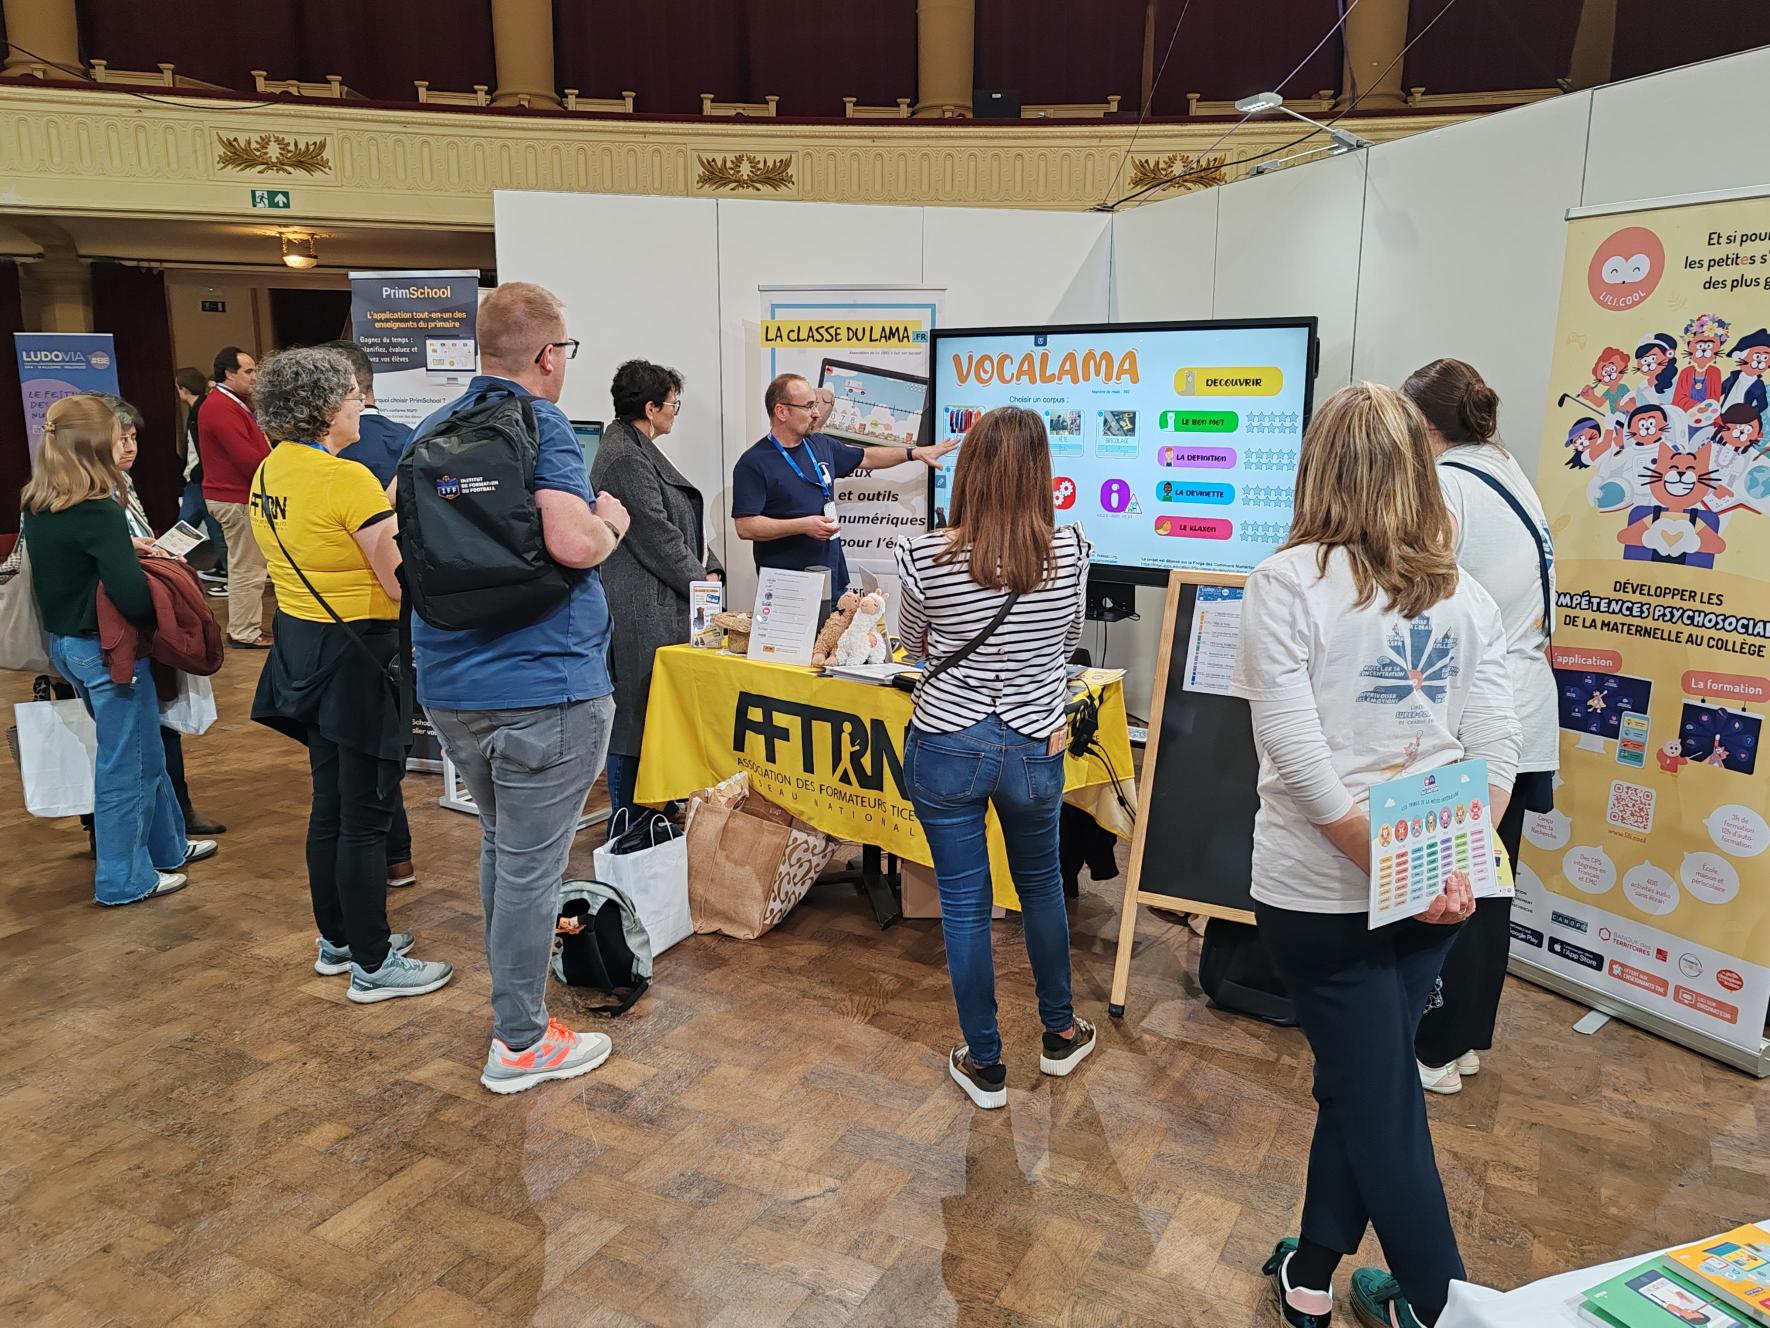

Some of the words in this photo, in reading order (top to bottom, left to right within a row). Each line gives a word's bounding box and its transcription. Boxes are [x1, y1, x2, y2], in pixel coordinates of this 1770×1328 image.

[1707, 231, 1723, 246] Et
[1725, 230, 1738, 245] si
[1684, 255, 1704, 270] les
[1707, 252, 1757, 272] petites
[1702, 275, 1728, 290] des
[1730, 273, 1761, 292] plus
[382, 286, 451, 299] PrimSchool
[1599, 290, 1647, 307] LILI.COOL
[366, 311, 412, 320] L'application
[413, 311, 453, 319] tout-en-un
[454, 310, 467, 319] des
[374, 321, 418, 330] enseignants
[418, 320, 428, 328] du
[428, 320, 460, 329] primaire
[764, 325, 784, 342] LA
[846, 326, 866, 342] DU
[869, 325, 911, 343] LAMA
[22, 351, 86, 361] LUDOVIA
[952, 350, 1140, 385] VOCALAMA
[1205, 378, 1262, 387] DECOUVRIR
[1009, 395, 1031, 403] Choisir
[1042, 397, 1065, 405] corpus
[838, 490, 853, 501] et
[857, 490, 899, 502] outils
[838, 513, 926, 528] numériques
[1613, 579, 1697, 603] DÉVELOPPER
[1699, 592, 1724, 606] LES
[1555, 590, 1651, 618] MPÉTENCES
[1563, 614, 1579, 627] DE
[1581, 616, 1597, 630] LA
[1600, 619, 1683, 644] MATERNELLE
[1685, 632, 1704, 646] AU
[1707, 635, 1766, 658] COLLÈGE
[1691, 678, 1704, 689] La
[1707, 679, 1763, 695] formation
[737, 757, 792, 786] ASSOCIATION
[796, 777, 816, 792] DES
[819, 784, 887, 813] FORMATEURS
[890, 804, 915, 822] TICE
[1527, 933, 1539, 945] Play
[1579, 954, 1597, 966] Store
